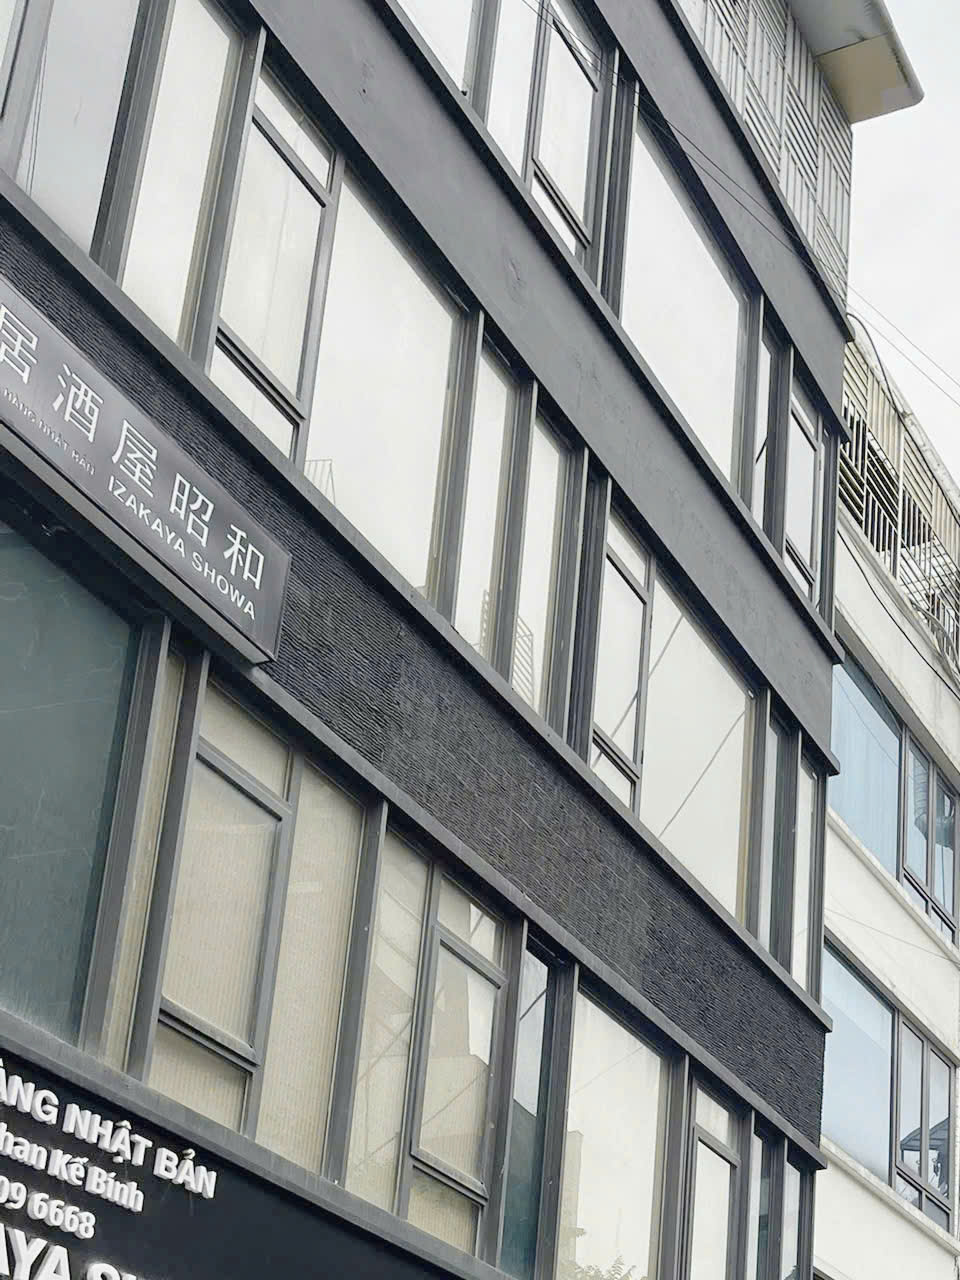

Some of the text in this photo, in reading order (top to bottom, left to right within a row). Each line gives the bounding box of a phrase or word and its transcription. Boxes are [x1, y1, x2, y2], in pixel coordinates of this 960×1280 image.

[0, 305, 266, 591] 居酒屋昭和
[109, 475, 256, 620] IZAKAYA SHOWA
[47, 1149, 89, 1187] Kế
[85, 1165, 144, 1213] Bính
[62, 1103, 152, 1167] NHẬT
[153, 1148, 217, 1199] BẢN
[27, 1191, 96, 1239] 6668
